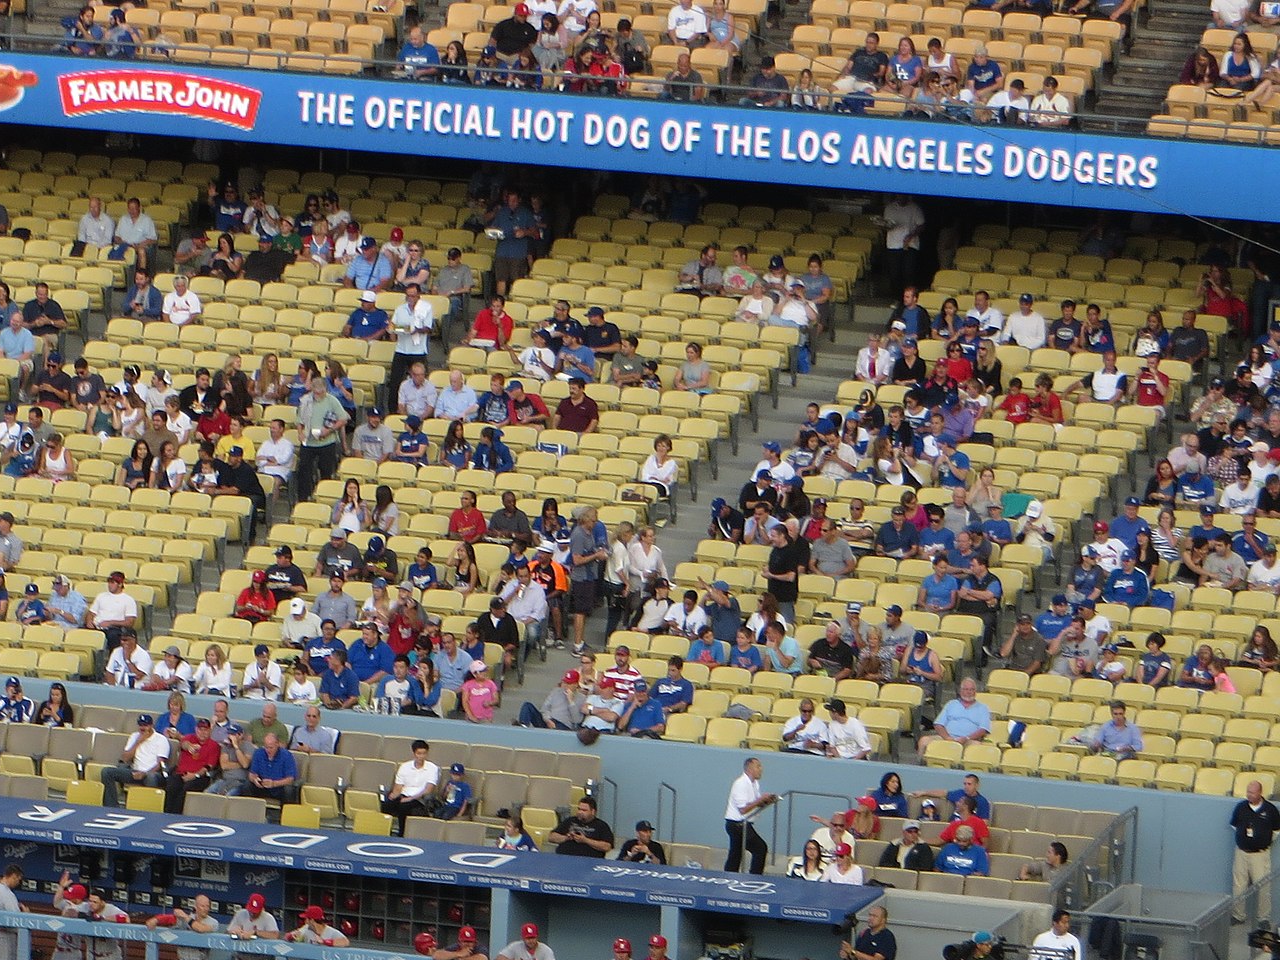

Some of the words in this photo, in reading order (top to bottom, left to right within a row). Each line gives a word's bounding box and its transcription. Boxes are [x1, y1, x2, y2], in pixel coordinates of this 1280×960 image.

[895, 63, 909, 80] LA
[70, 80, 174, 108] FARMER
[175, 80, 250, 118] JOHN
[297, 91, 354, 126] THE
[364, 96, 501, 138] OFFICIAL
[511, 108, 574, 143] HOT
[584, 113, 650, 150] DOG
[660, 119, 701, 153] OF
[712, 123, 771, 159] THE
[781, 128, 841, 165] LOS
[850, 134, 993, 176] ANGELES
[1004, 145, 1159, 189] DODGERS
[17, 804, 518, 868] DODGER
[3, 916, 42, 928] TRUST
[94, 926, 112, 936] U.S.
[117, 928, 155, 941] TRUST
[208, 937, 226, 948] U.S.
[230, 940, 269, 953] TRUST
